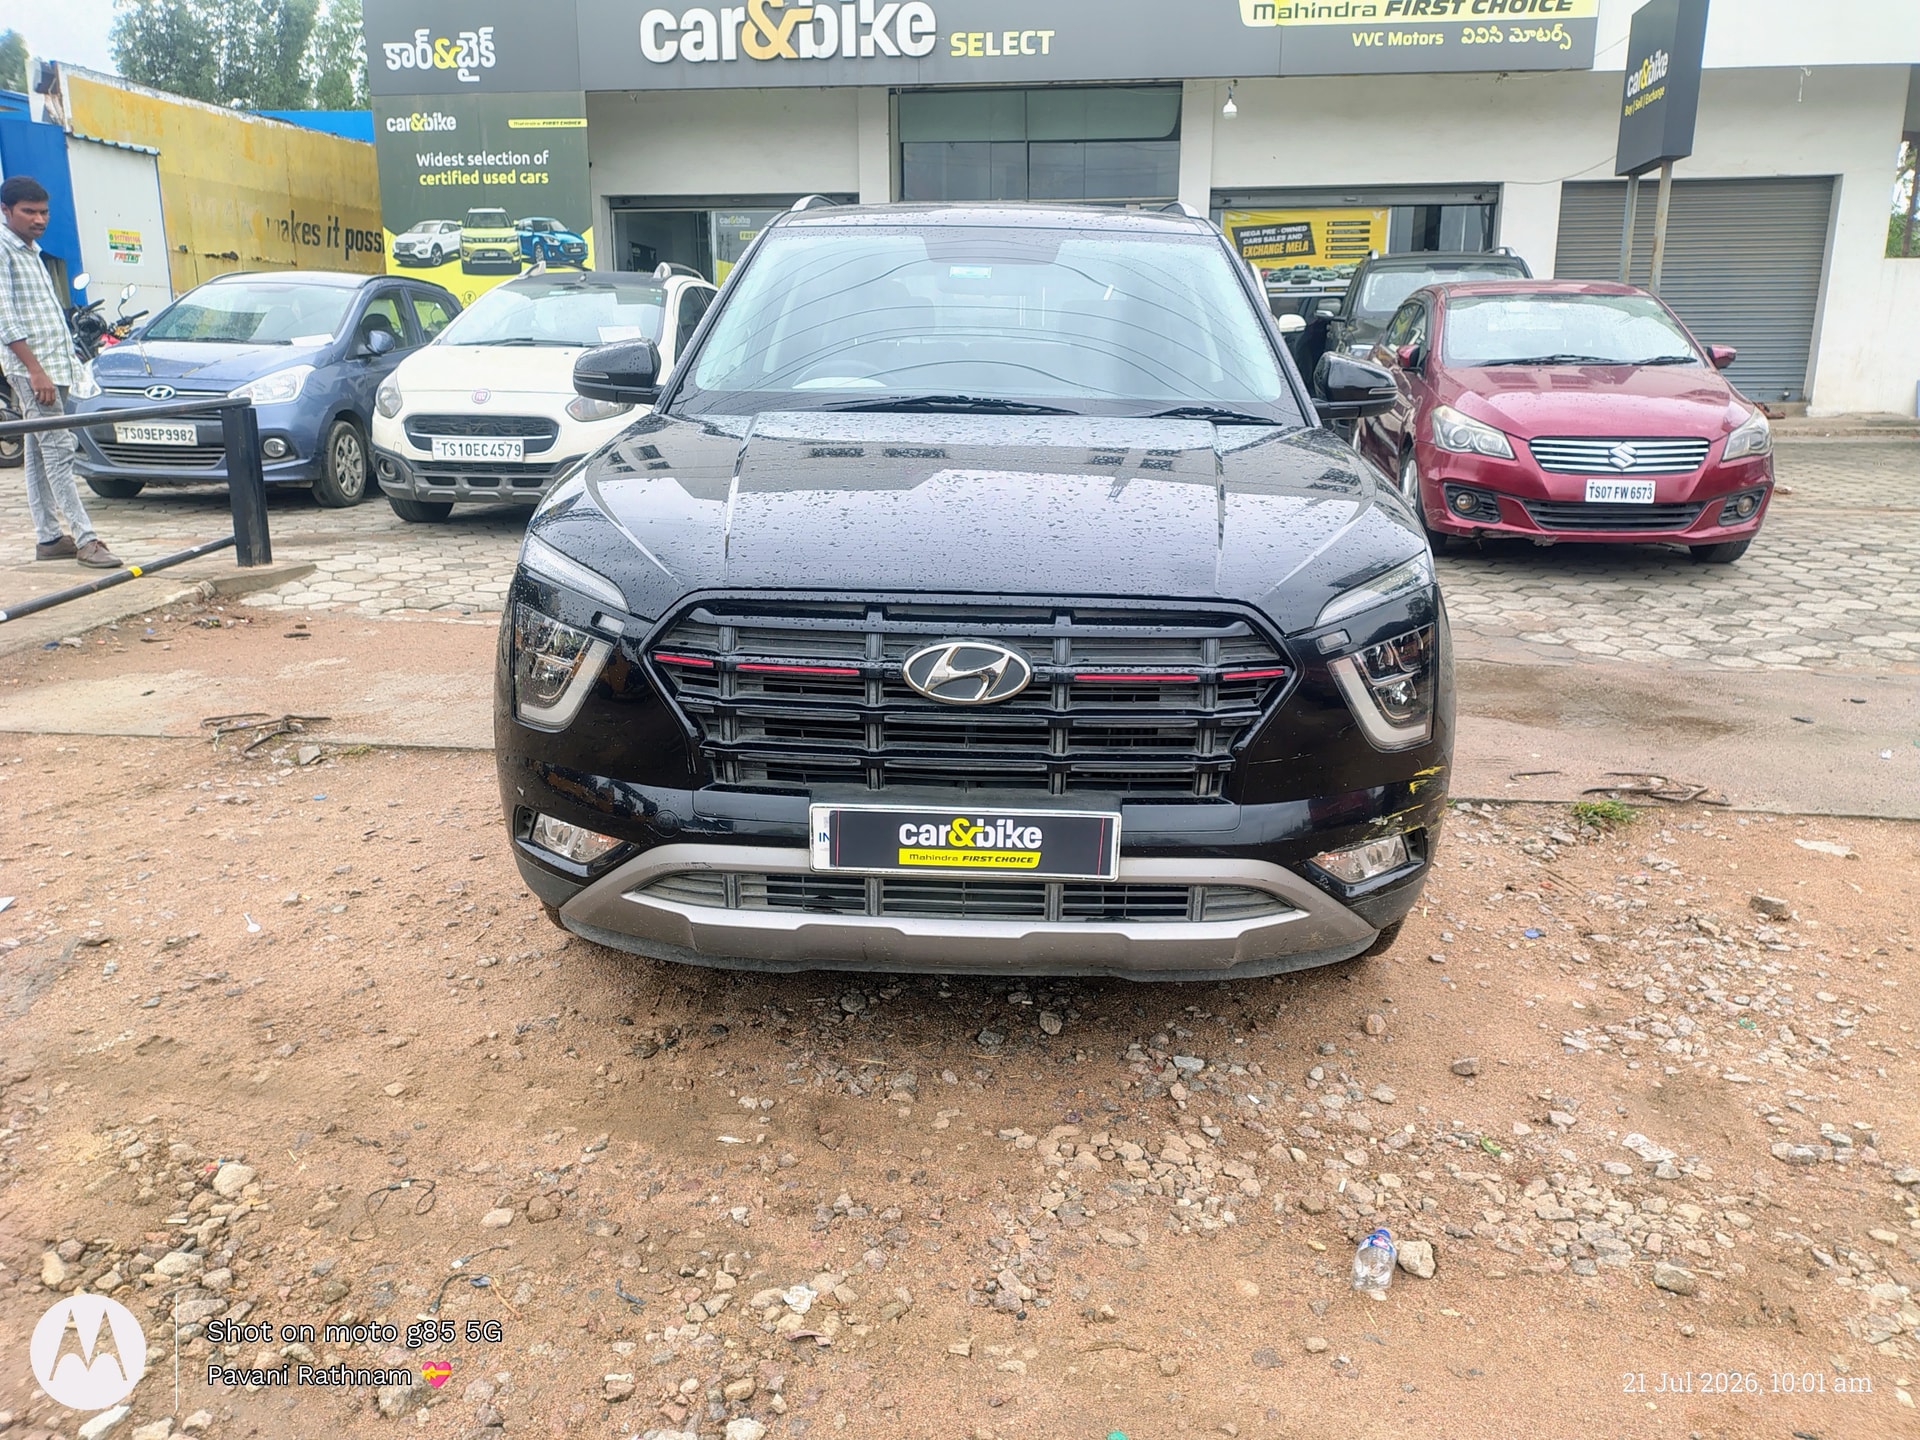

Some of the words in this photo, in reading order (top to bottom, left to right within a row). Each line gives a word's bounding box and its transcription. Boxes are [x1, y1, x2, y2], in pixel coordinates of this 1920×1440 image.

[1253, 3, 1376, 20] Mahindra
[1384, 0, 1463, 16] FIRST
[1471, 0, 1573, 14] CHOICE
[639, 0, 937, 63] car&bike
[950, 30, 1056, 57] SELECT
[1352, 31, 1384, 47] VVC
[1388, 31, 1444, 46] Motors
[1461, 25, 1504, 44] వివిసి
[383, 26, 496, 83] కార్&బైక్
[1627, 49, 1669, 98] car&bike
[386, 112, 457, 133] car&bike
[416, 152, 464, 167] Widest
[467, 150, 530, 165] selection
[534, 150, 549, 165] of
[419, 170, 480, 186] certified
[483, 169, 516, 185] used
[519, 170, 549, 184] cars
[327, 215, 340, 248] it
[1243, 237, 1262, 245] CARS
[1263, 235, 1286, 243] SALES
[1287, 233, 1303, 241] AND
[1262, 228, 1277, 236] PRE
[1281, 226, 1308, 234] OWNED
[1242, 242, 1285, 258] EXCHANGE
[1285, 240, 1309, 253] MELA
[124, 426, 194, 442] TS09EP9982
[441, 443, 522, 458] TS10EC4579
[1589, 485, 1612, 499] TS07
[1614, 487, 1629, 499] FW
[1630, 487, 1653, 500] 6573
[899, 817, 1043, 849] car&bike
[909, 853, 958, 862] Mahindra
[961, 855, 994, 863] FIRST
[994, 856, 1034, 864] CHOICE
